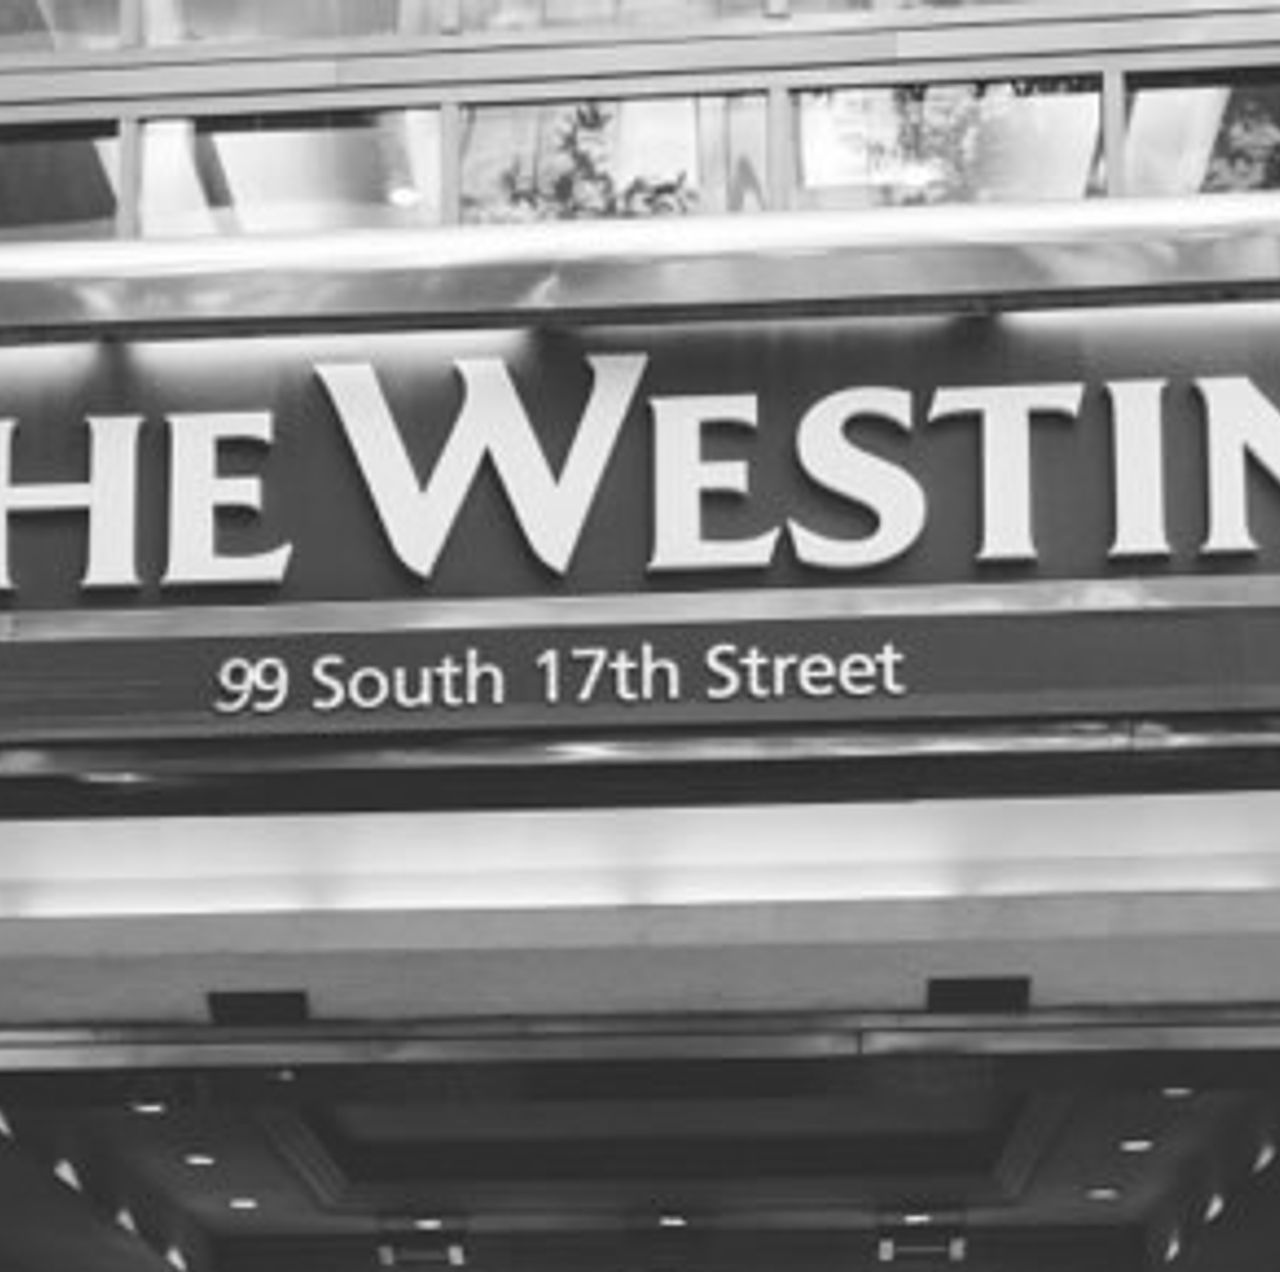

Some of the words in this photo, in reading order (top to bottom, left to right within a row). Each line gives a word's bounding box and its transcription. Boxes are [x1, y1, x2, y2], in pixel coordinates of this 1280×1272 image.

[214, 656, 288, 713] 99
[311, 650, 505, 710] South
[535, 643, 681, 702] 17th
[705, 640, 906, 699] Street
